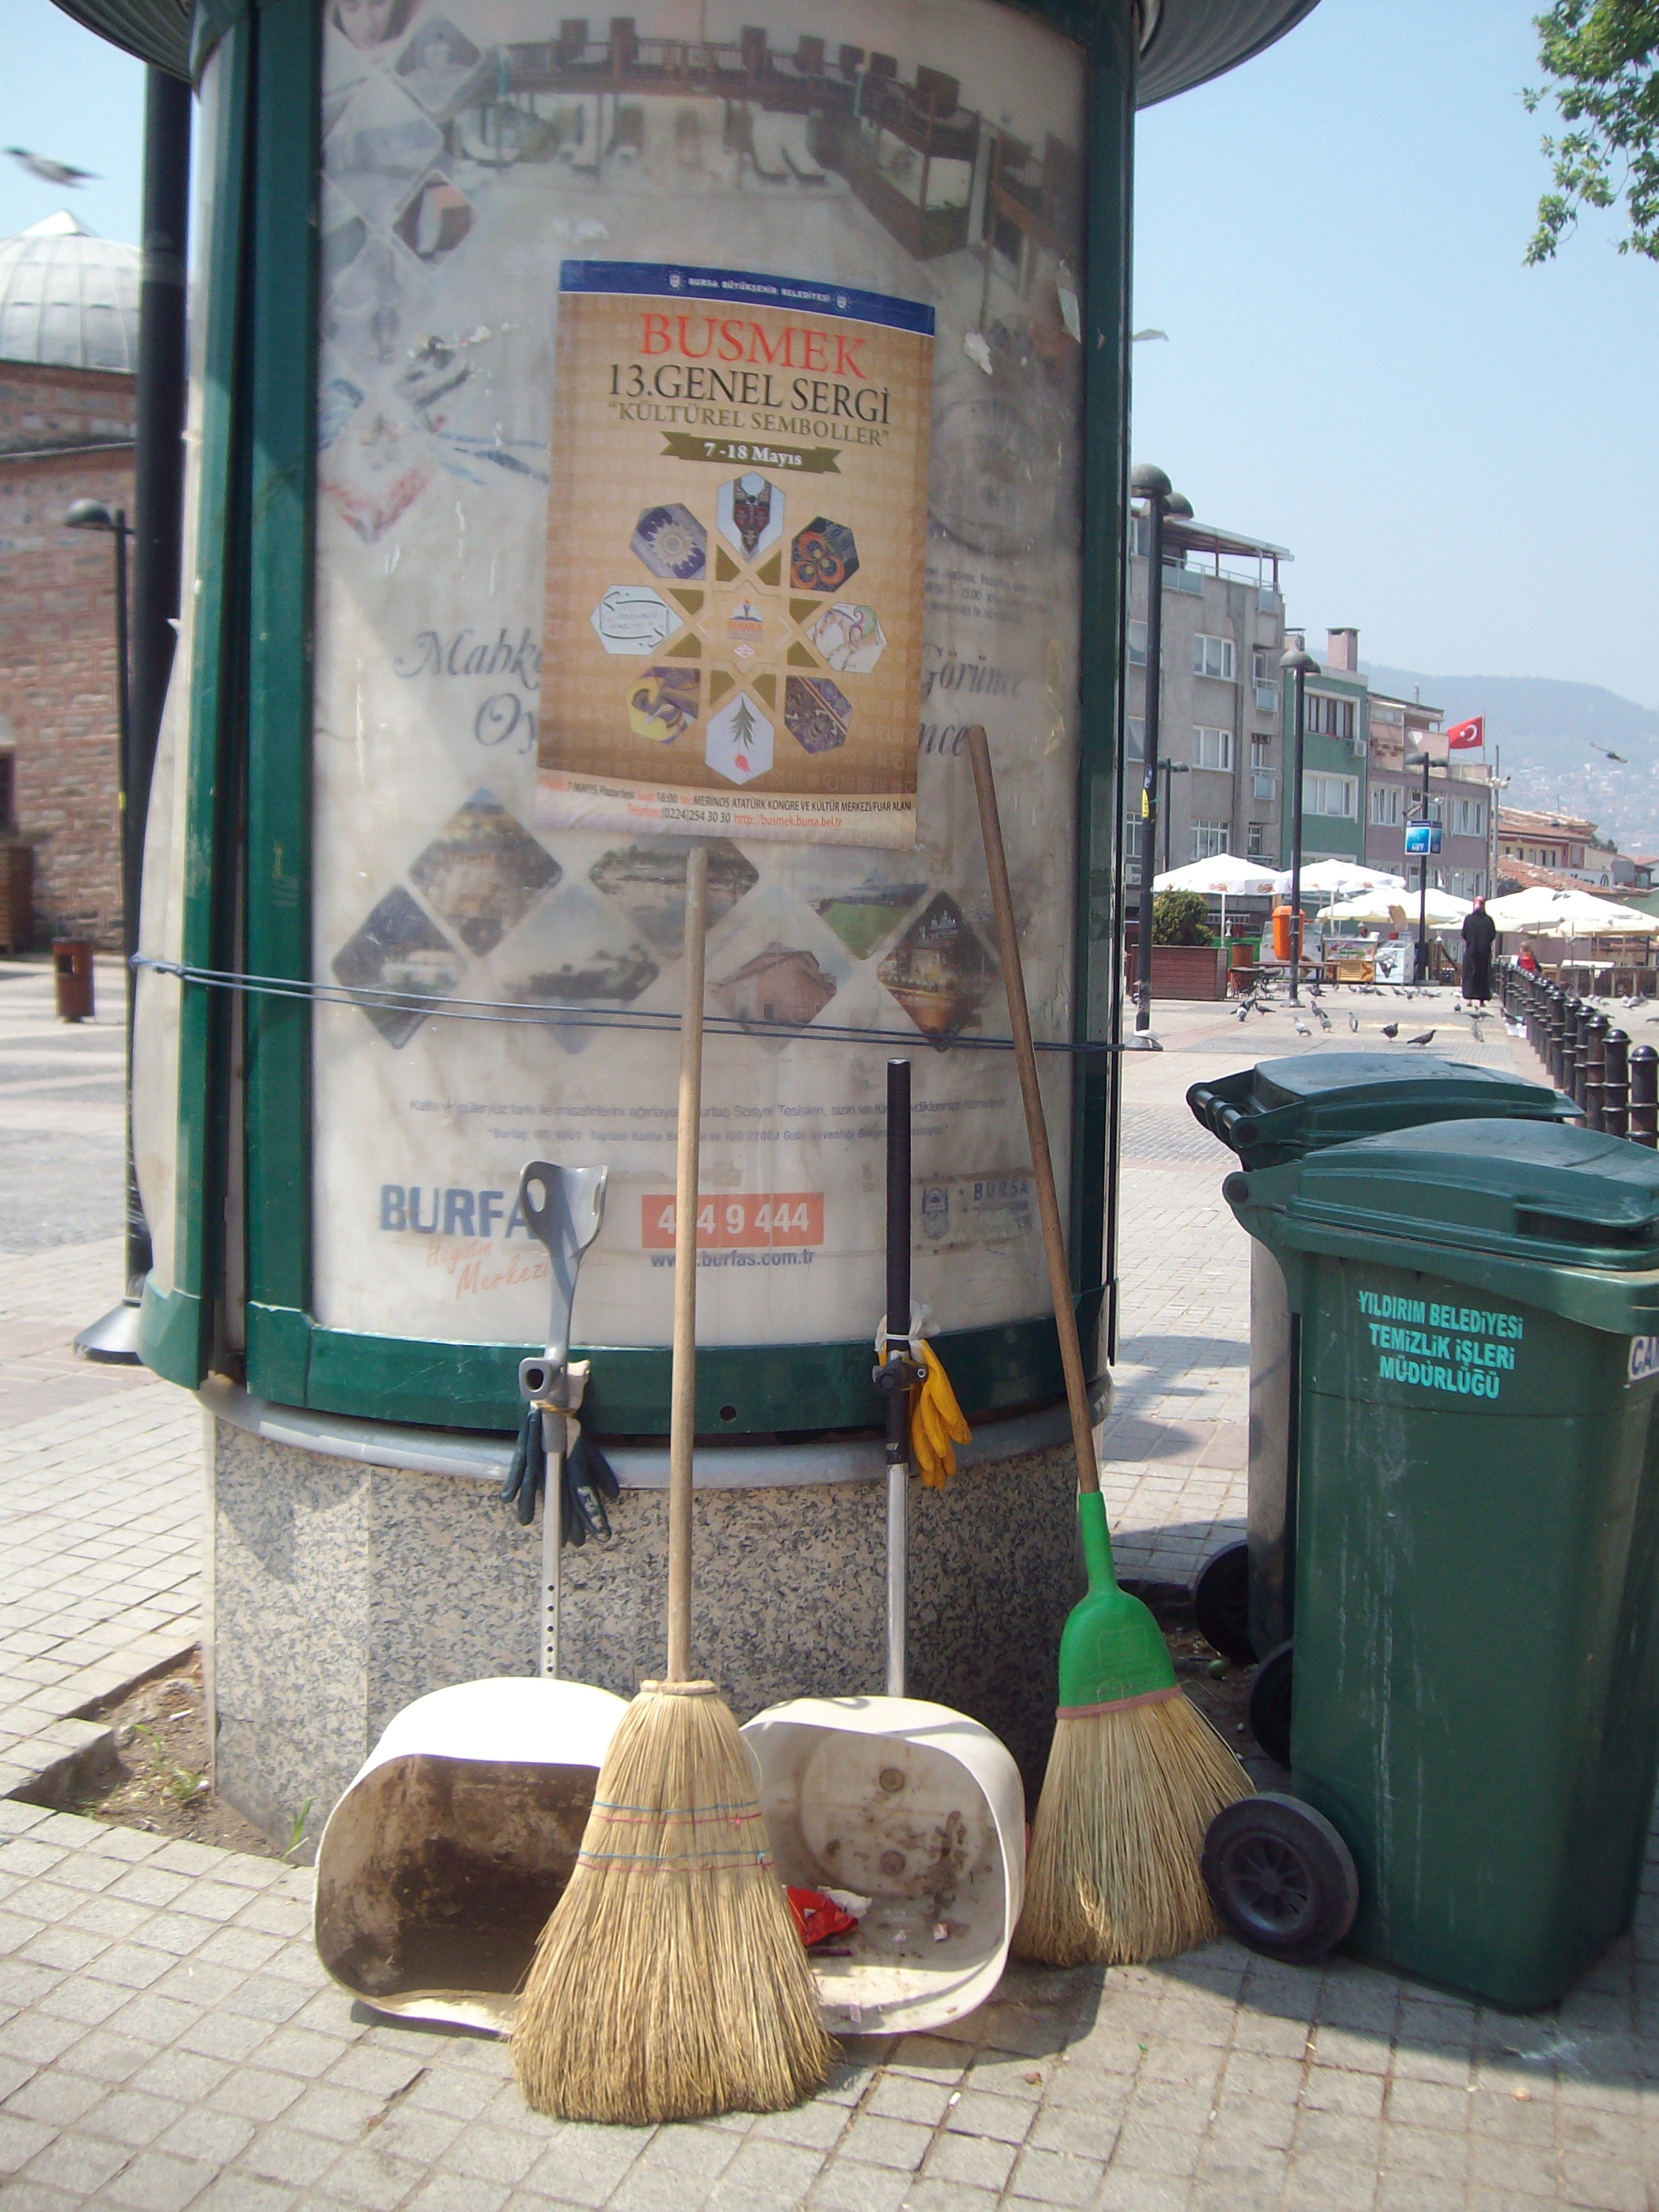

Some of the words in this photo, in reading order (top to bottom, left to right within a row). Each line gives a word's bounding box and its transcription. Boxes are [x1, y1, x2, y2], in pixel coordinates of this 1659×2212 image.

[688, 277, 719, 288] BURSA
[639, 313, 868, 379] BUSMEK
[608, 363, 783, 408] 13.GENEL
[791, 377, 891, 423] SERGİ
[703, 441, 714, 457] 7
[750, 446, 803, 467] Mayıs
[707, 811, 718, 822] 30
[719, 811, 731, 823] 30
[734, 813, 842, 827] http://busmek.bursa.bel.tr
[732, 797, 766, 810] ATATÜRK
[768, 799, 799, 811] KONGRE
[801, 801, 810, 811] VE
[811, 799, 840, 812] KÜLTÜR
[892, 801, 912, 811] ALANI
[657, 1204, 716, 1235] 44
[725, 1204, 745, 1234] 9
[754, 1202, 809, 1233] 444
[651, 1248, 815, 1268] ww.burfas.com.tr
[1358, 1290, 1425, 1325] YILDIRIM
[1429, 1303, 1524, 1340] BELEDİYESİ
[1369, 1323, 1451, 1361] TEMİZLİK
